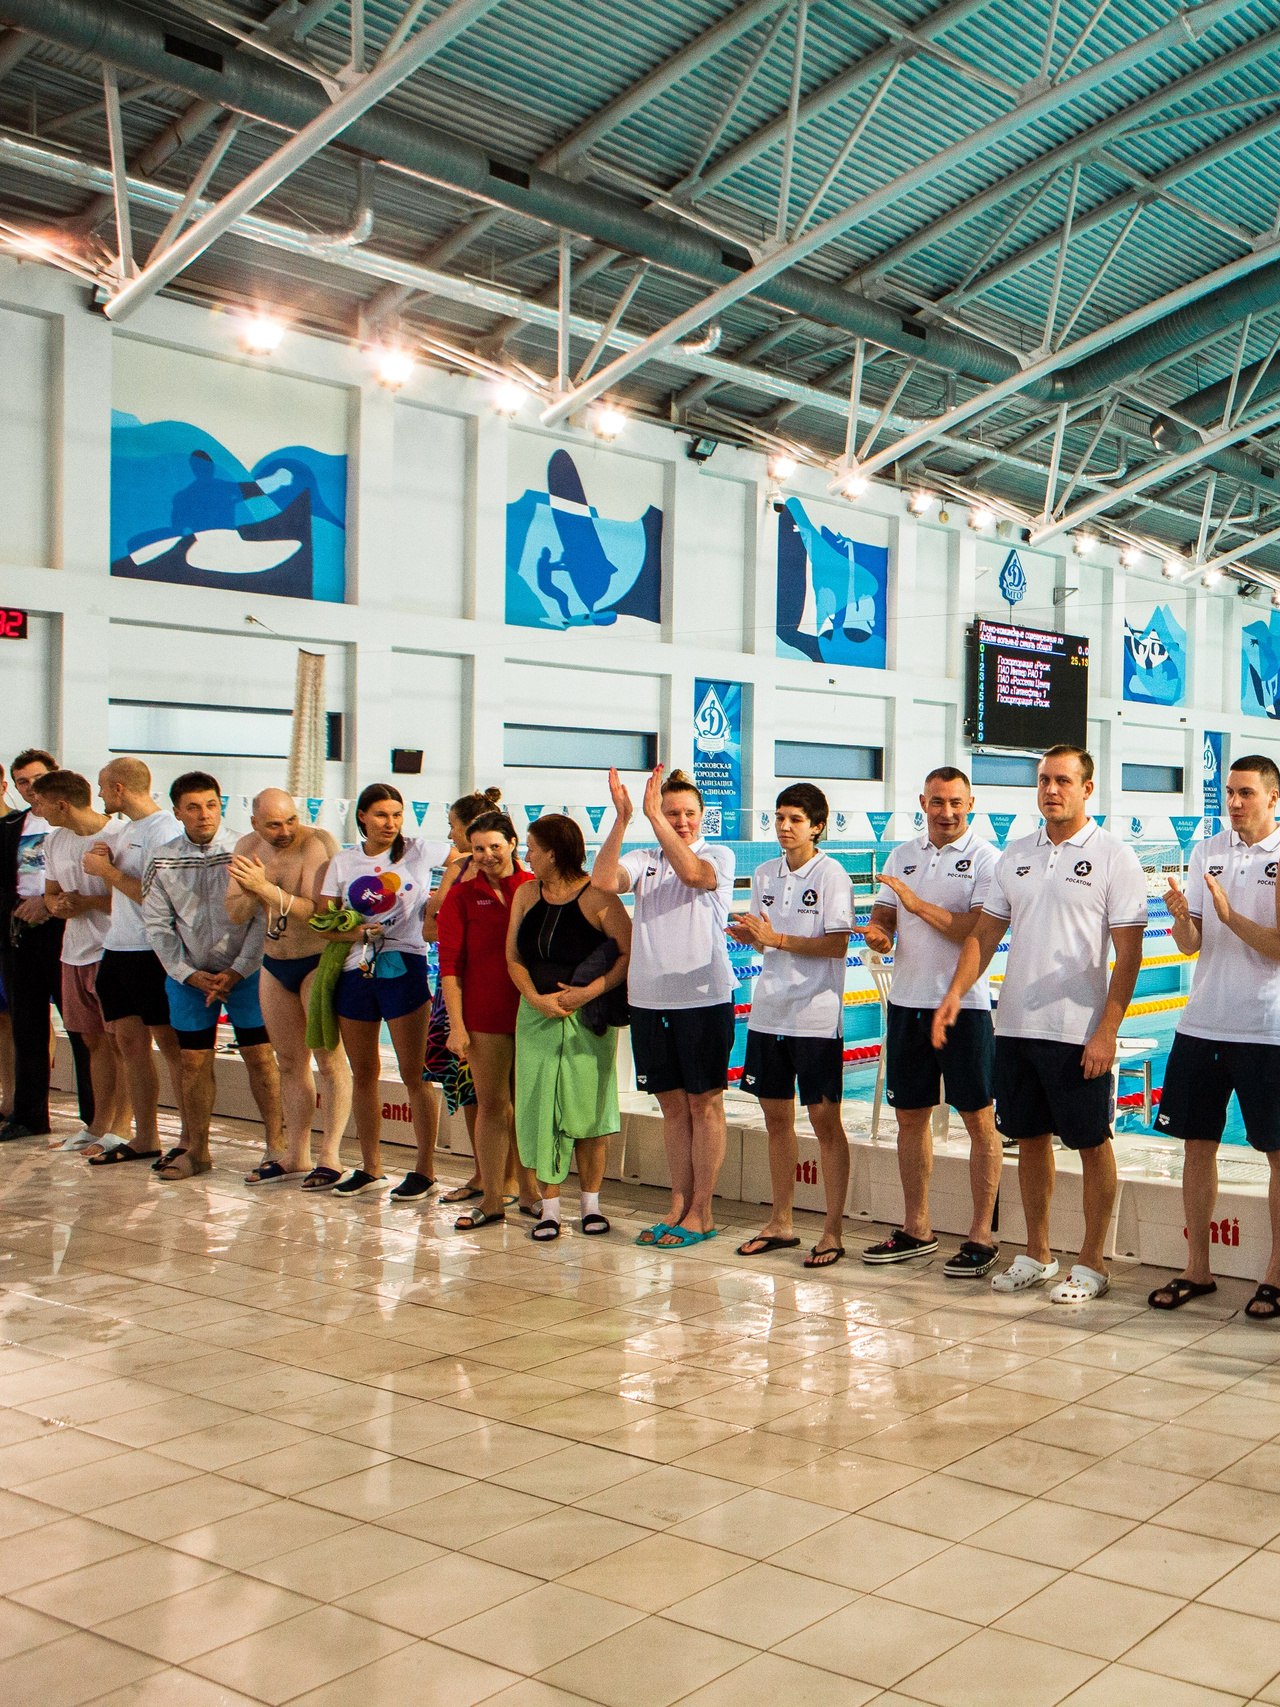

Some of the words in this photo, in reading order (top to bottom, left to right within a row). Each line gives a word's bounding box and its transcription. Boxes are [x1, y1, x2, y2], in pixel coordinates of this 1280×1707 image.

[997, 664, 1010, 674] ПАО
[997, 674, 1010, 684] ПАО
[997, 683, 1010, 694] ПАО
[1065, 877, 1092, 887] РОСАТОМ
[382, 1102, 412, 1123] anti
